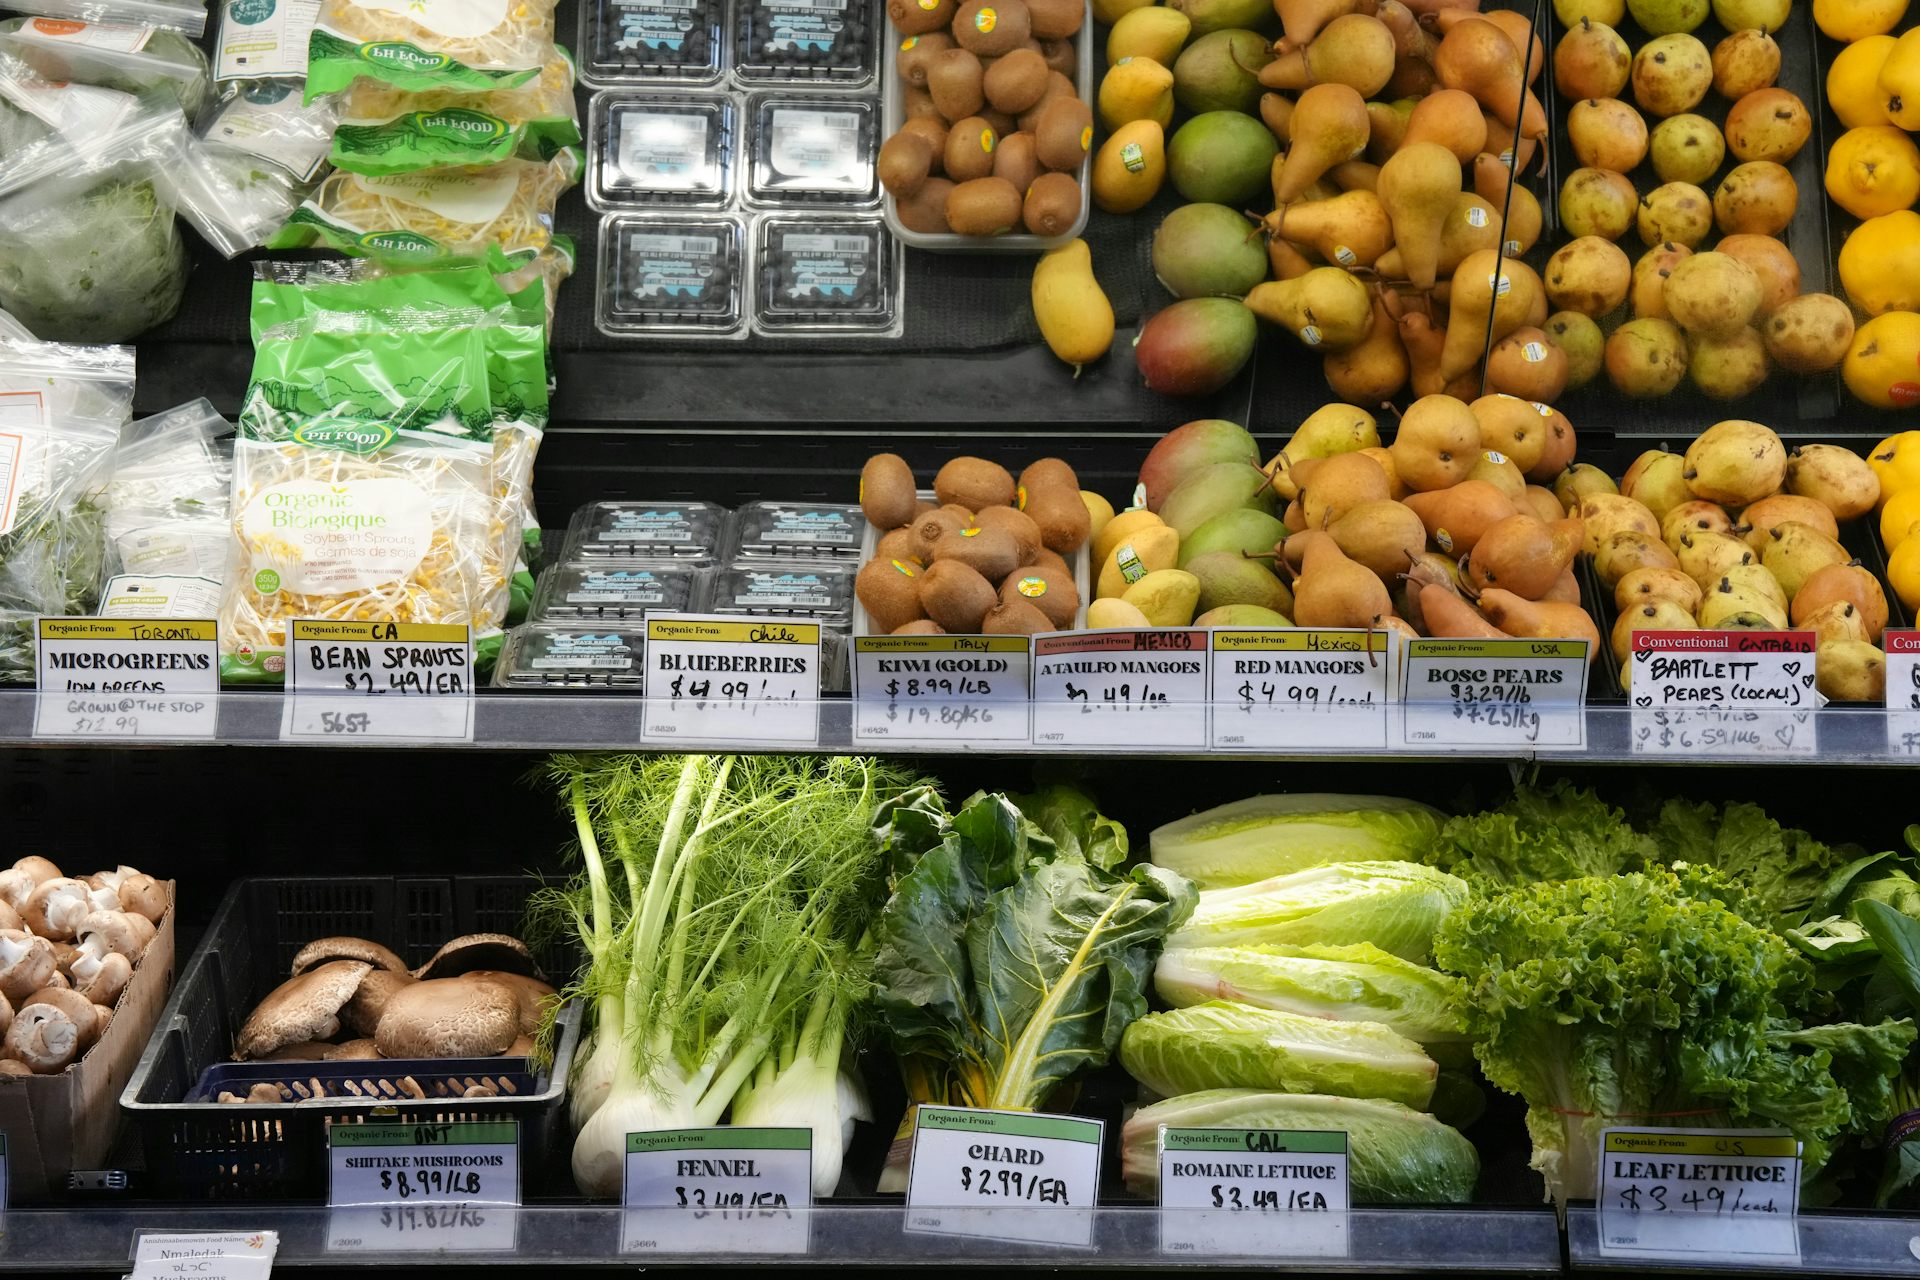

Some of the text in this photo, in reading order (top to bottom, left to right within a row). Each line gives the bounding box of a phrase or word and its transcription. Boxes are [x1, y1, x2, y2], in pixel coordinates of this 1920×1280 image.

[306, 431, 381, 445] PH FOOD
[264, 492, 354, 513] Organic
[272, 510, 386, 531] Biologique
[49, 624, 87, 636] Organic
[90, 624, 116, 635] From:
[301, 623, 399, 640] Organic From: CA
[656, 625, 800, 642] Organic From: Chile
[863, 640, 901, 650] Organic
[954, 639, 990, 653] ITALY
[1043, 638, 1104, 649] Conventional
[1133, 631, 1192, 651] MEXICO
[1221, 633, 1361, 652] Organic From: Mexico
[1418, 644, 1561, 655] Organic From: USA
[1638, 635, 1729, 648] Conventional
[48, 652, 210, 670] MICROGREENS
[310, 646, 372, 671] BEAN
[382, 647, 466, 669] SPROUTS
[659, 653, 807, 674] BLUEBERRIES
[878, 659, 1008, 674] KIWI (GOLD)
[1041, 661, 1201, 675] ATAULFO MANGOES
[1234, 660, 1365, 675] RED MANGOES
[1427, 668, 1564, 684] BOSC PEARS
[1650, 657, 1759, 682] BARTLETT
[1663, 684, 1725, 702] PEARS
[171, 701, 205, 714] STOP
[321, 711, 372, 734] 5657
[928, 1112, 997, 1127] Organic From:
[340, 1130, 380, 1142] Organic
[635, 1136, 676, 1147] Organic
[1170, 1132, 1287, 1153] Organic From: CAL
[967, 1143, 1045, 1167] CHARD
[1614, 1137, 1745, 1156] Organic From: US
[413, 1155, 504, 1168] MUSHROOMS
[676, 1159, 761, 1177] FENNEL
[1172, 1162, 1337, 1181] ROMAINE LETTUCE
[1613, 1161, 1786, 1182] LEAF LETTUCE
[206, 1236, 223, 1244] Food
[161, 1249, 225, 1261] Nmaledak
